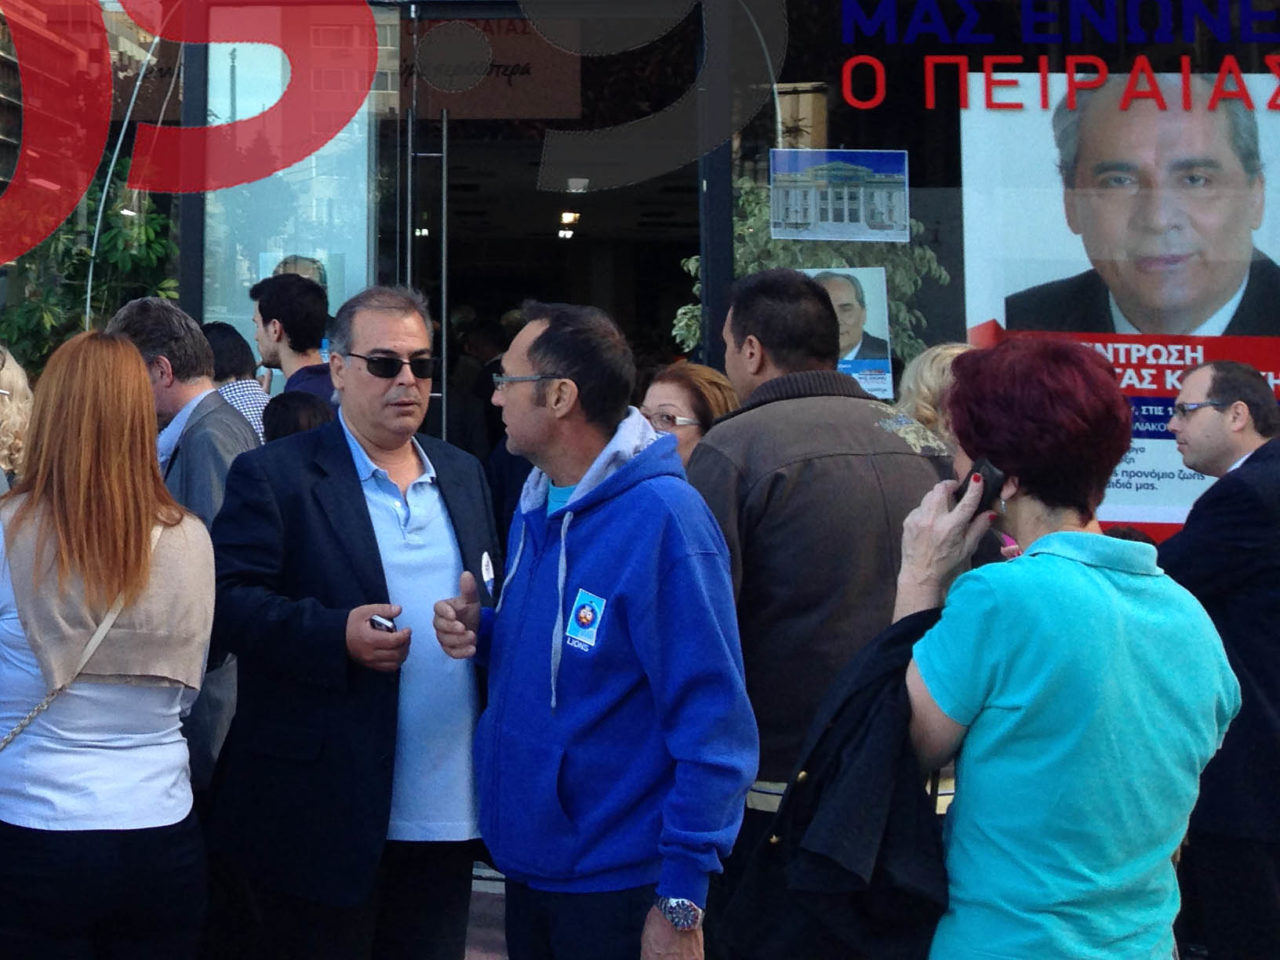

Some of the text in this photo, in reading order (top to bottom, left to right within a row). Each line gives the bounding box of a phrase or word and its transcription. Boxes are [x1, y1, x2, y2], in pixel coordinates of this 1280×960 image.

[840, 53, 1280, 112] Ο ΠΕΙΡΑΙΑΣ
[1092, 342, 1204, 365] ΝΤΡΩΣΗ
[1121, 469, 1176, 481] προνόμιο
[566, 637, 589, 652] LIONS
